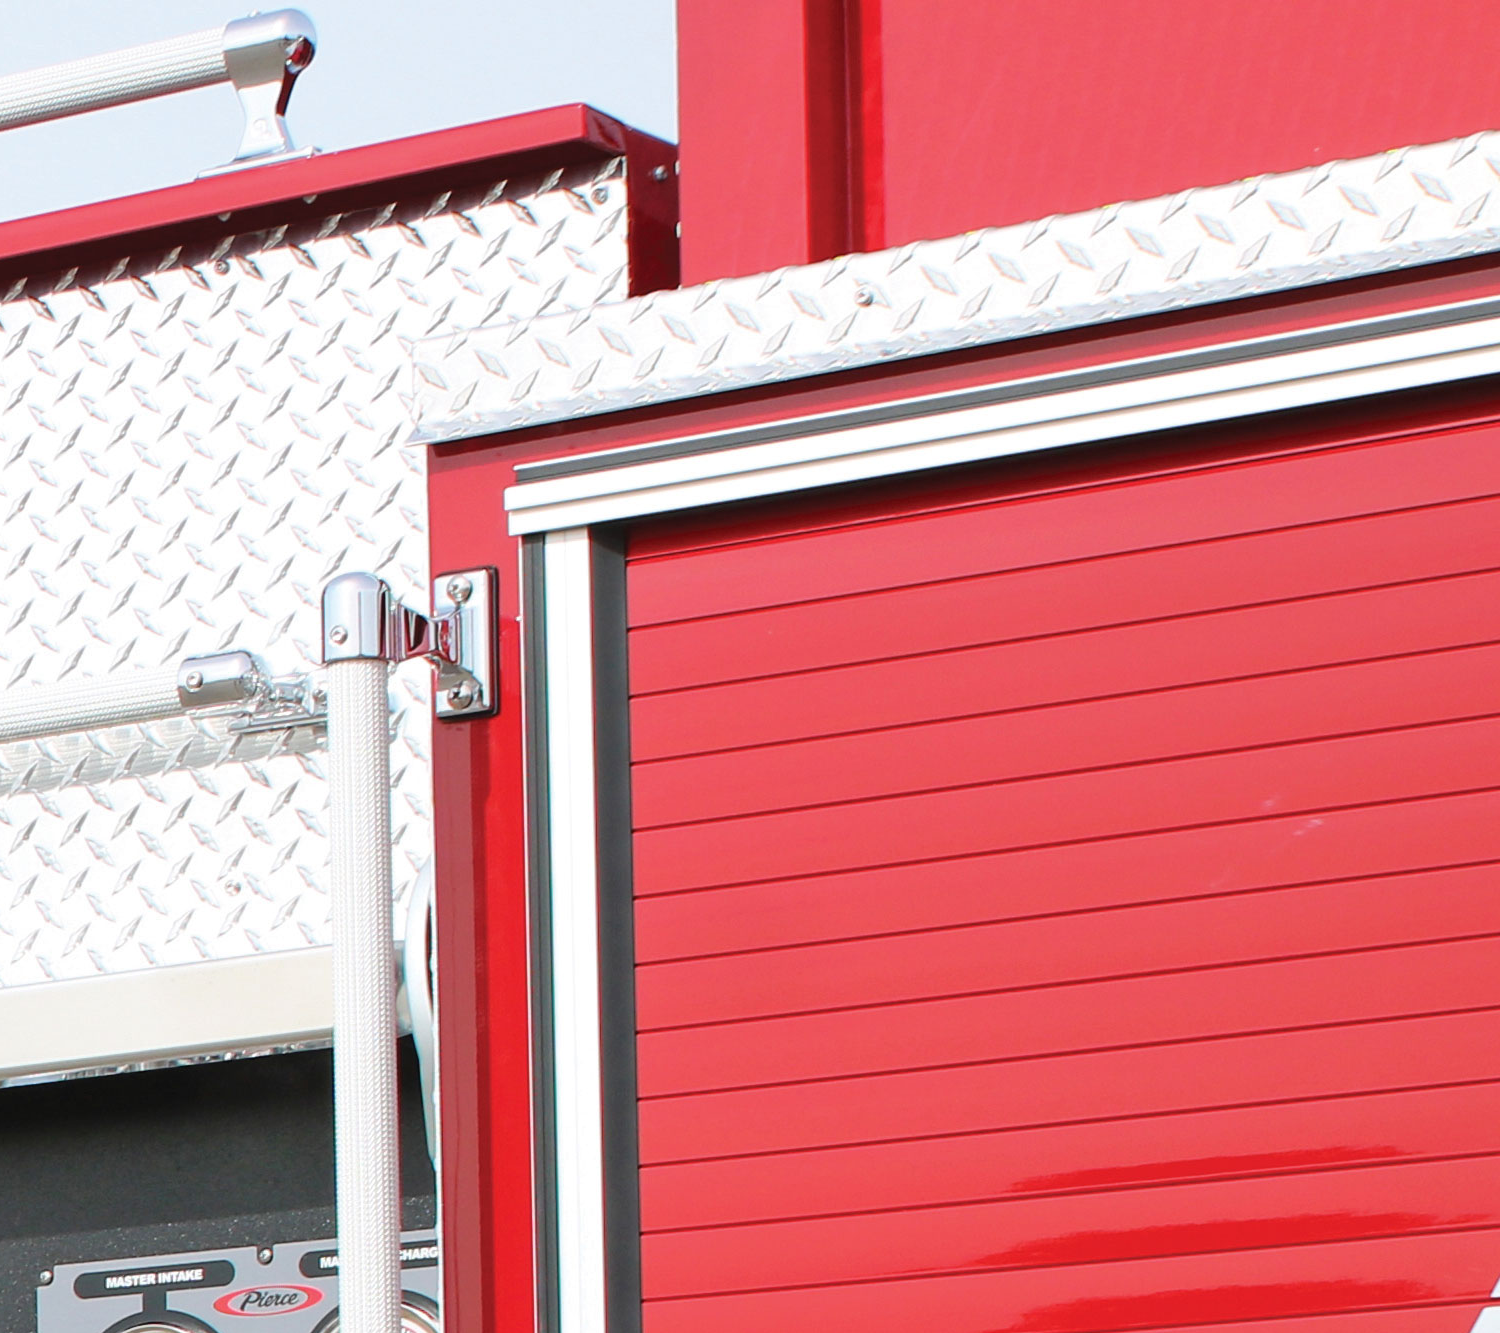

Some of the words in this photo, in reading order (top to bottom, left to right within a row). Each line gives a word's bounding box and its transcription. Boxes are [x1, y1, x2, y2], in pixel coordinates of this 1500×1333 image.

[105, 1273, 156, 1290] MASTER
[158, 1269, 203, 1285] INTAKE
[240, 1290, 299, 1312] Pierce
